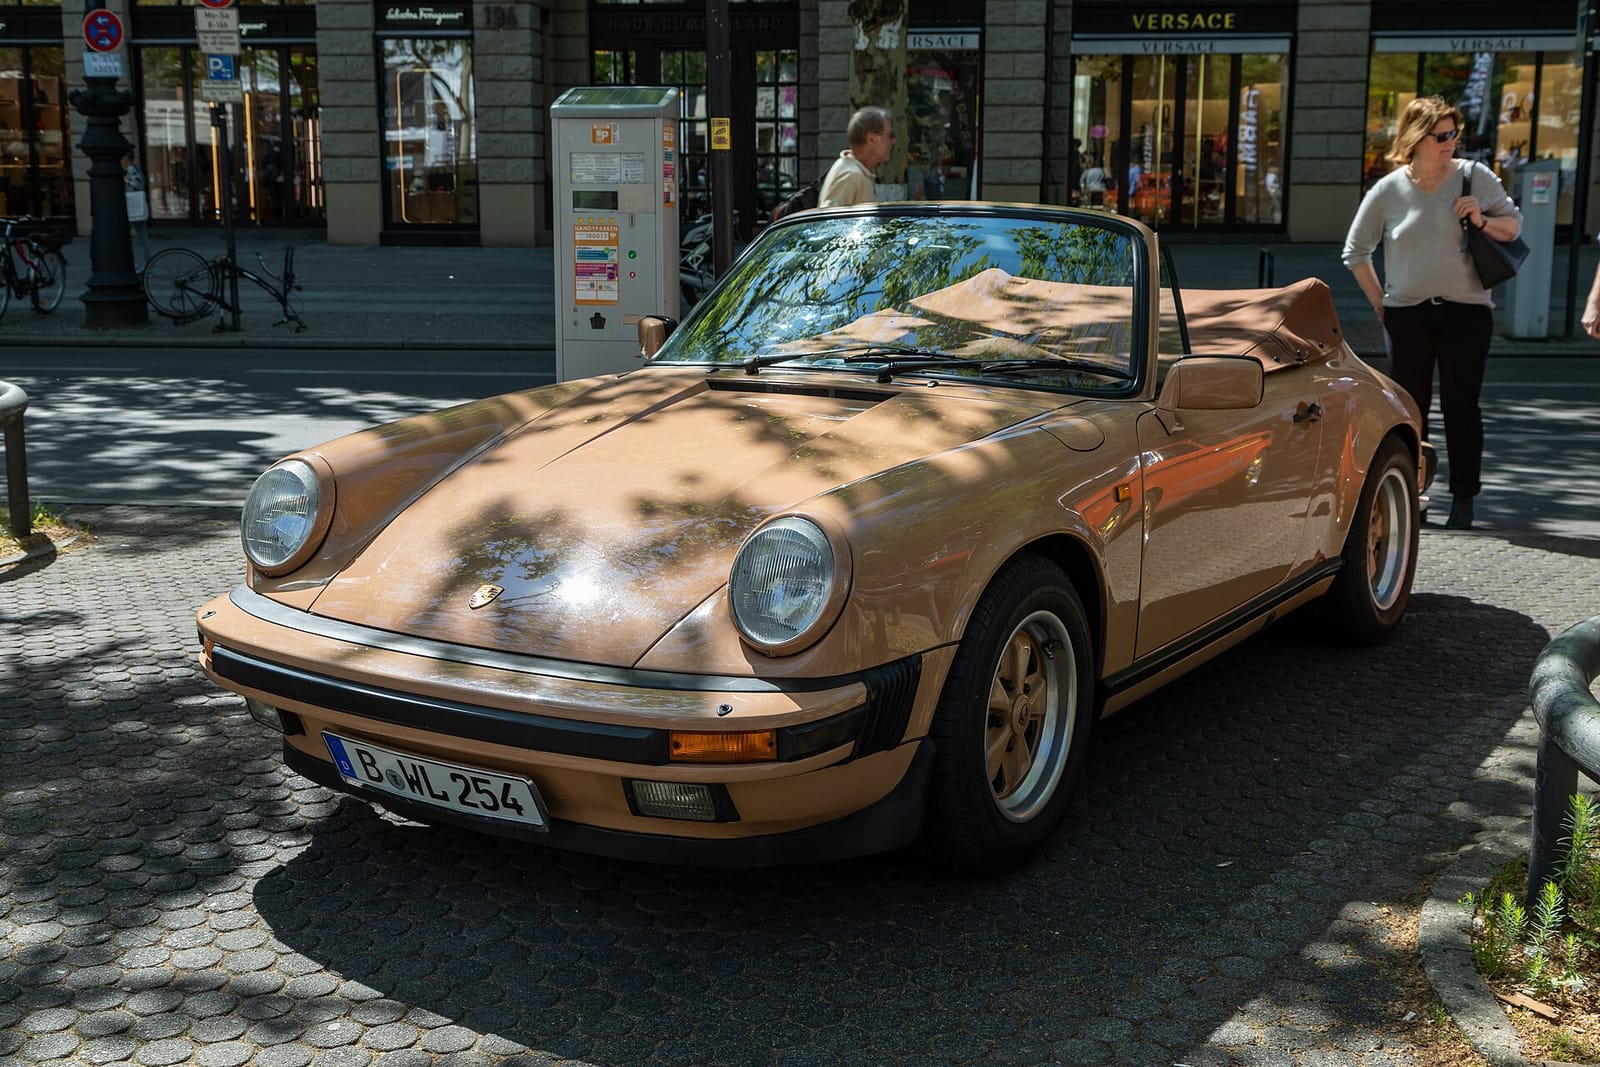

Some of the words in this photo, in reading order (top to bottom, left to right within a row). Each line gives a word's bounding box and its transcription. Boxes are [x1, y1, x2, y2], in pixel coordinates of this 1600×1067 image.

[1132, 13, 1236, 30] VERSACE
[912, 36, 966, 47] RSACE
[1142, 42, 1217, 53] VERSACE
[1451, 38, 1530, 50] VERSACE
[356, 748, 384, 783] B
[398, 759, 450, 802] WL
[450, 772, 525, 816] 254
